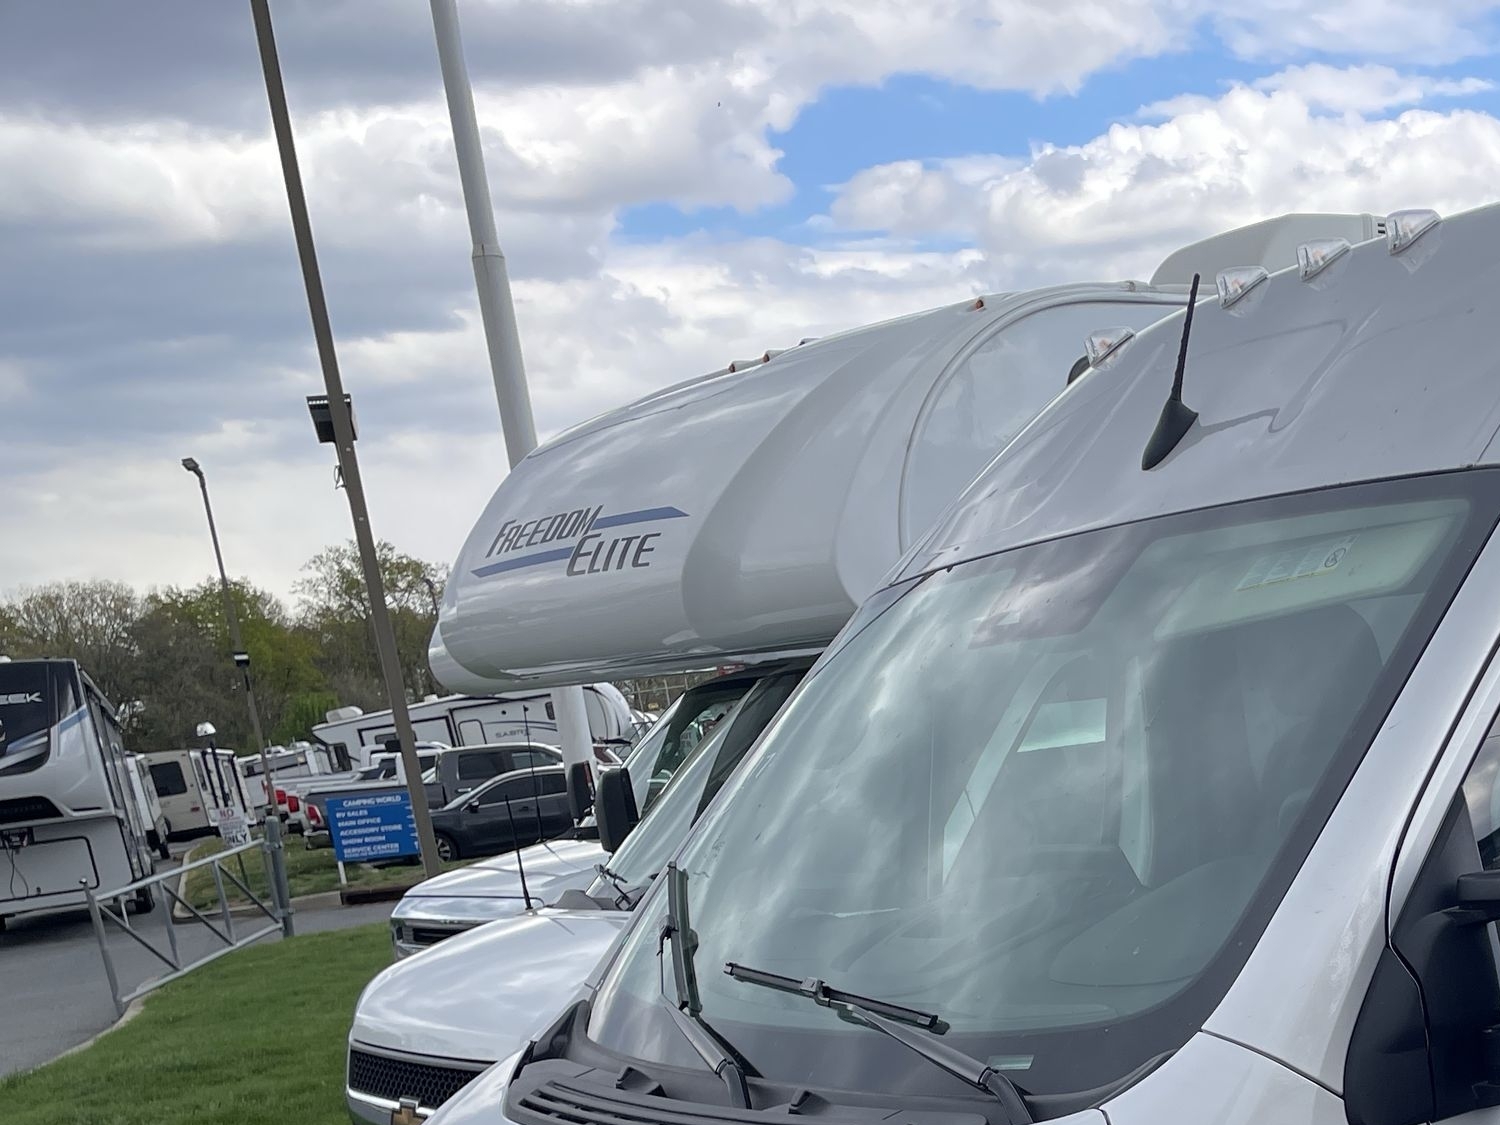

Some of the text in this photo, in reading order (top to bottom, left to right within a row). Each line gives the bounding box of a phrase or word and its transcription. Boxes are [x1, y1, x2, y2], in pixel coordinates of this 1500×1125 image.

[485, 504, 604, 559] FREEDOM
[566, 532, 661, 577] ELITE
[343, 795, 402, 808] CAMPING WORLD
[347, 809, 368, 817] SALES
[357, 817, 381, 825] OFFICE
